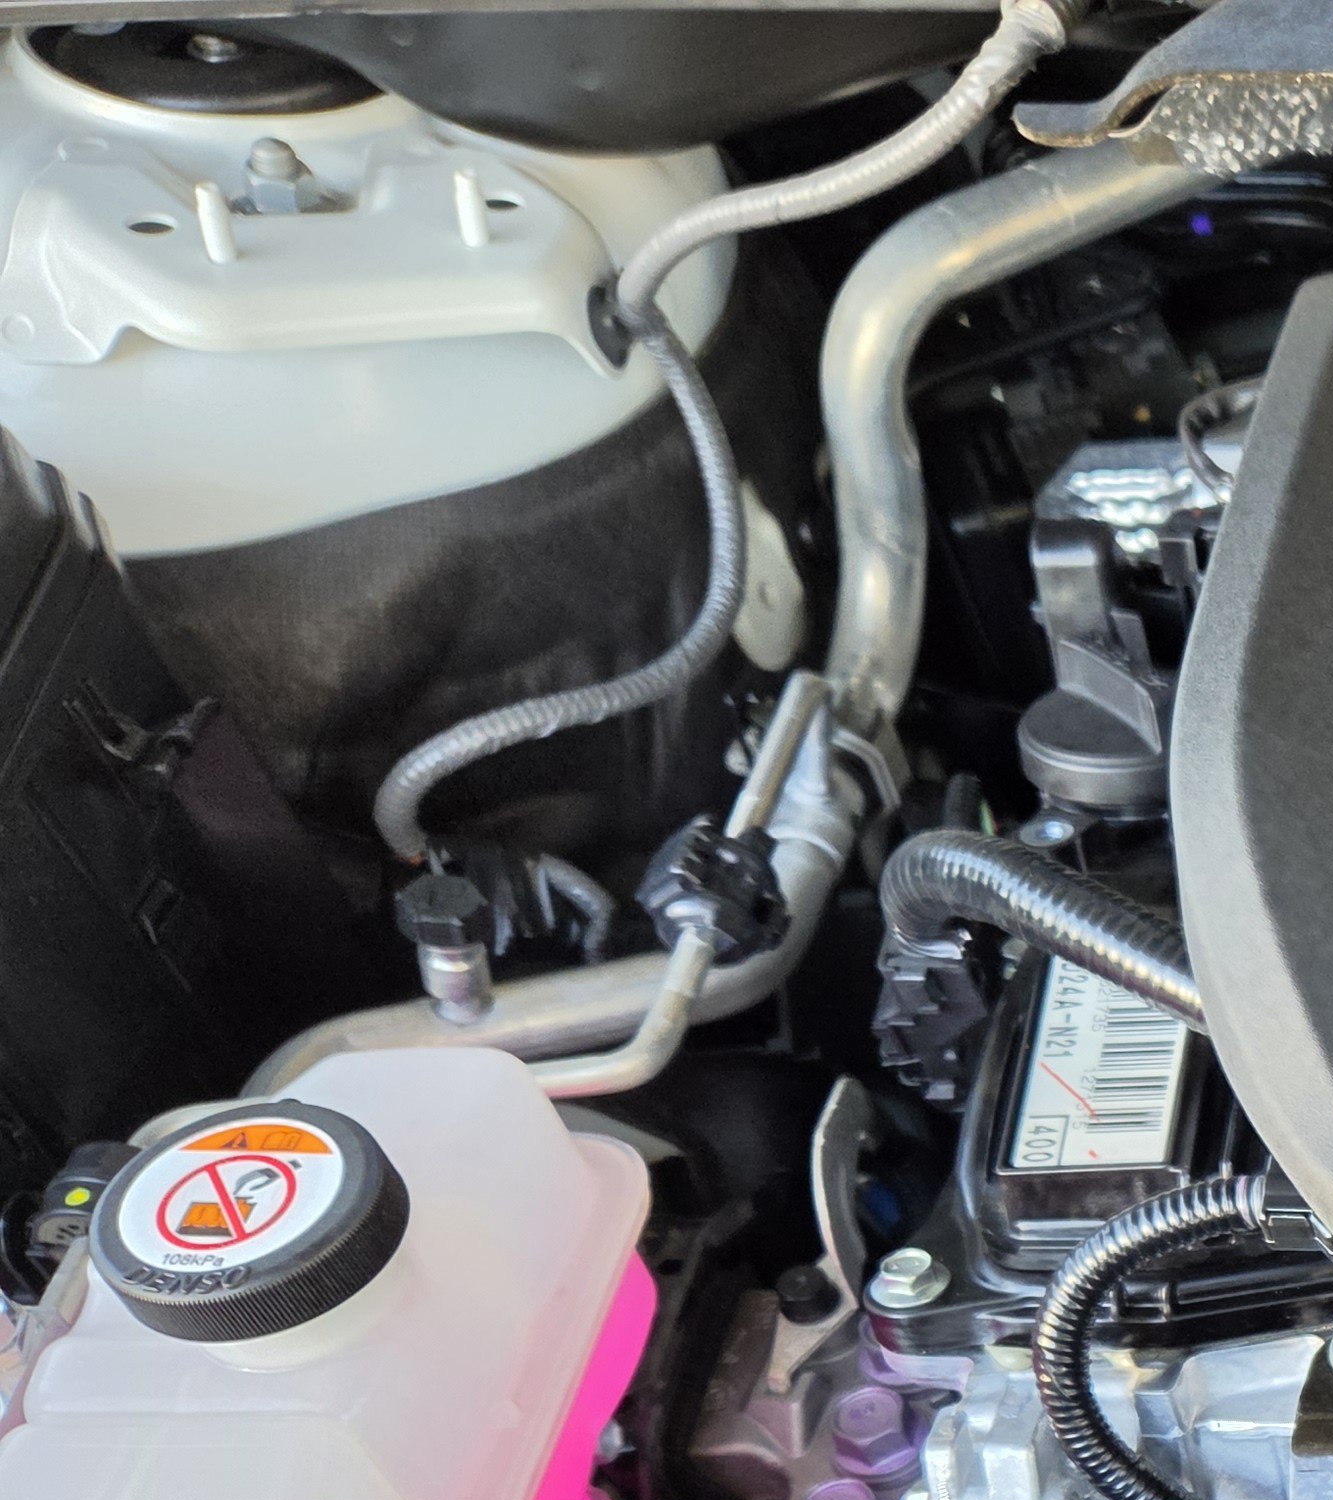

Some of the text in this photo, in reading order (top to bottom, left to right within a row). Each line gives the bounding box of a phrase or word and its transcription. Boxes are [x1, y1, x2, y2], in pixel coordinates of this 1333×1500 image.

[1022, 1125, 1060, 1162] 400
[161, 1253, 225, 1267] 108kPa
[121, 1265, 252, 1295] DENSO
